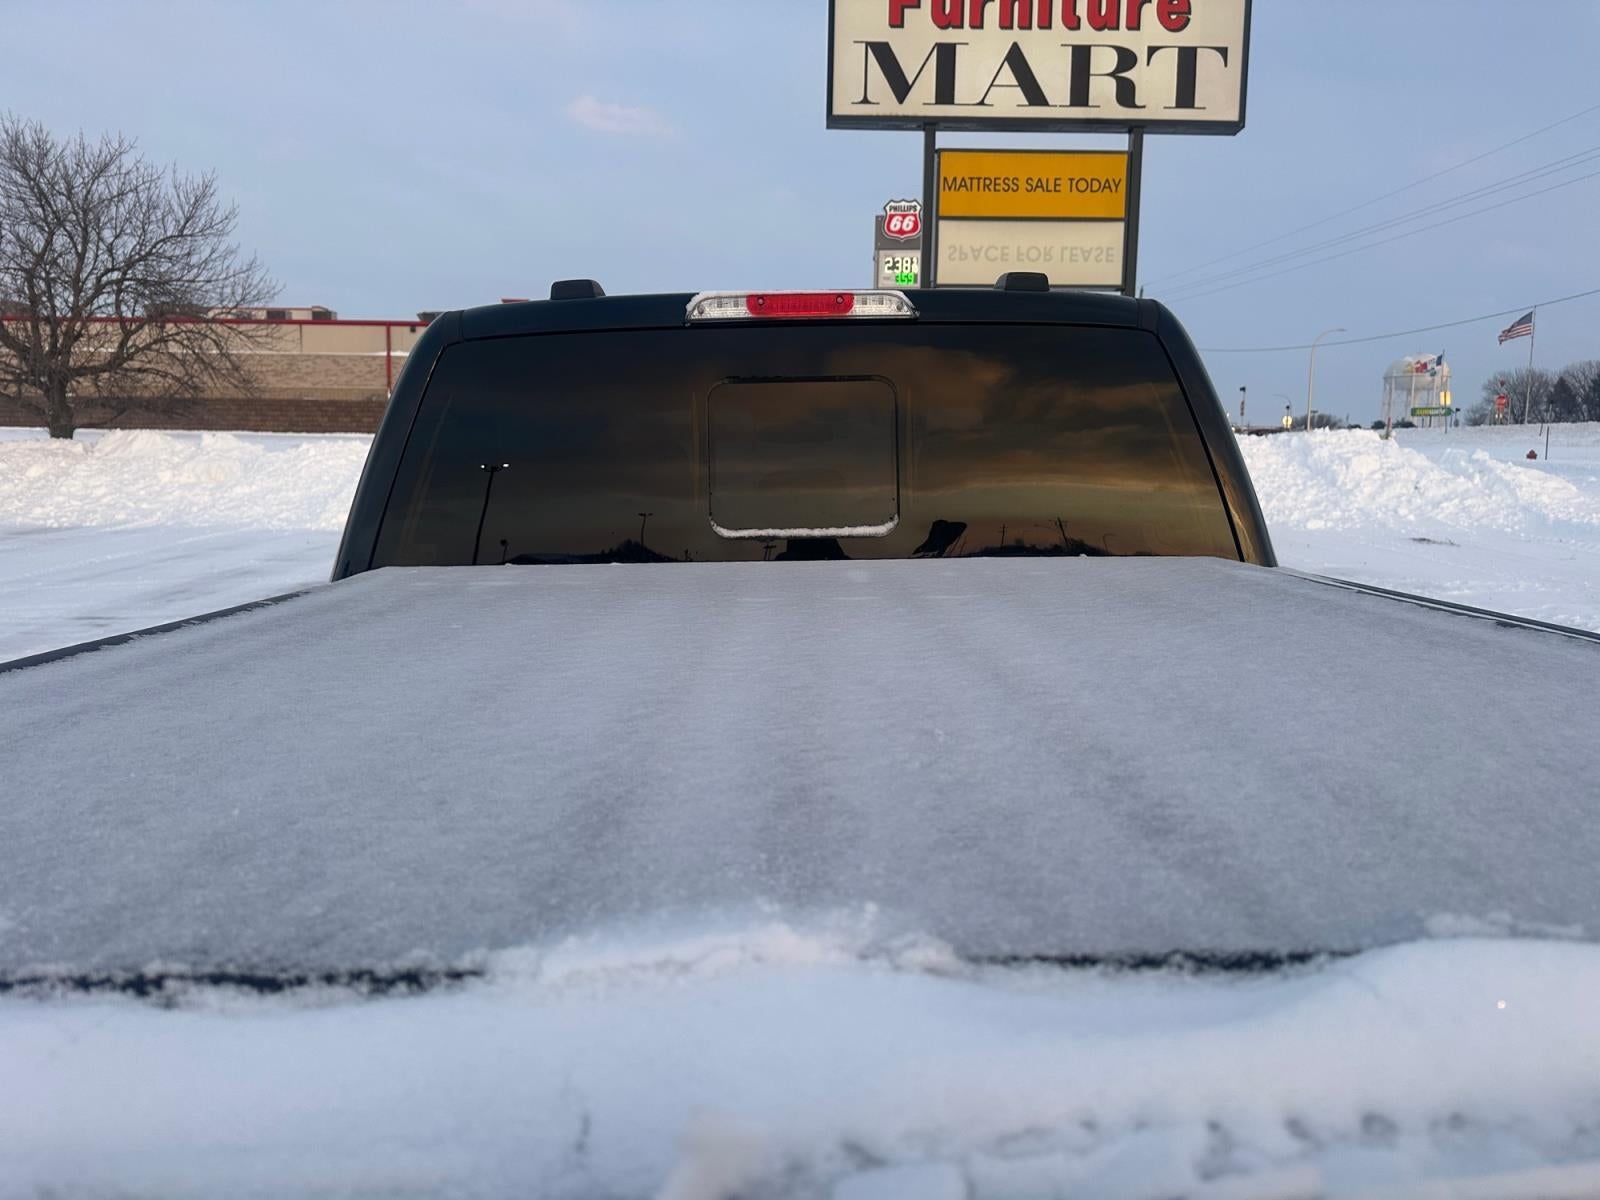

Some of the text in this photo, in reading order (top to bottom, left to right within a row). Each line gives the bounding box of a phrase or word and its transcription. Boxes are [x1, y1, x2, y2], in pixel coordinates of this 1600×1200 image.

[888, 0, 1192, 32] Furniture
[851, 40, 1229, 110] MART
[943, 176, 1122, 193] MATTRESS SALE TODAY
[889, 215, 915, 231] 66
